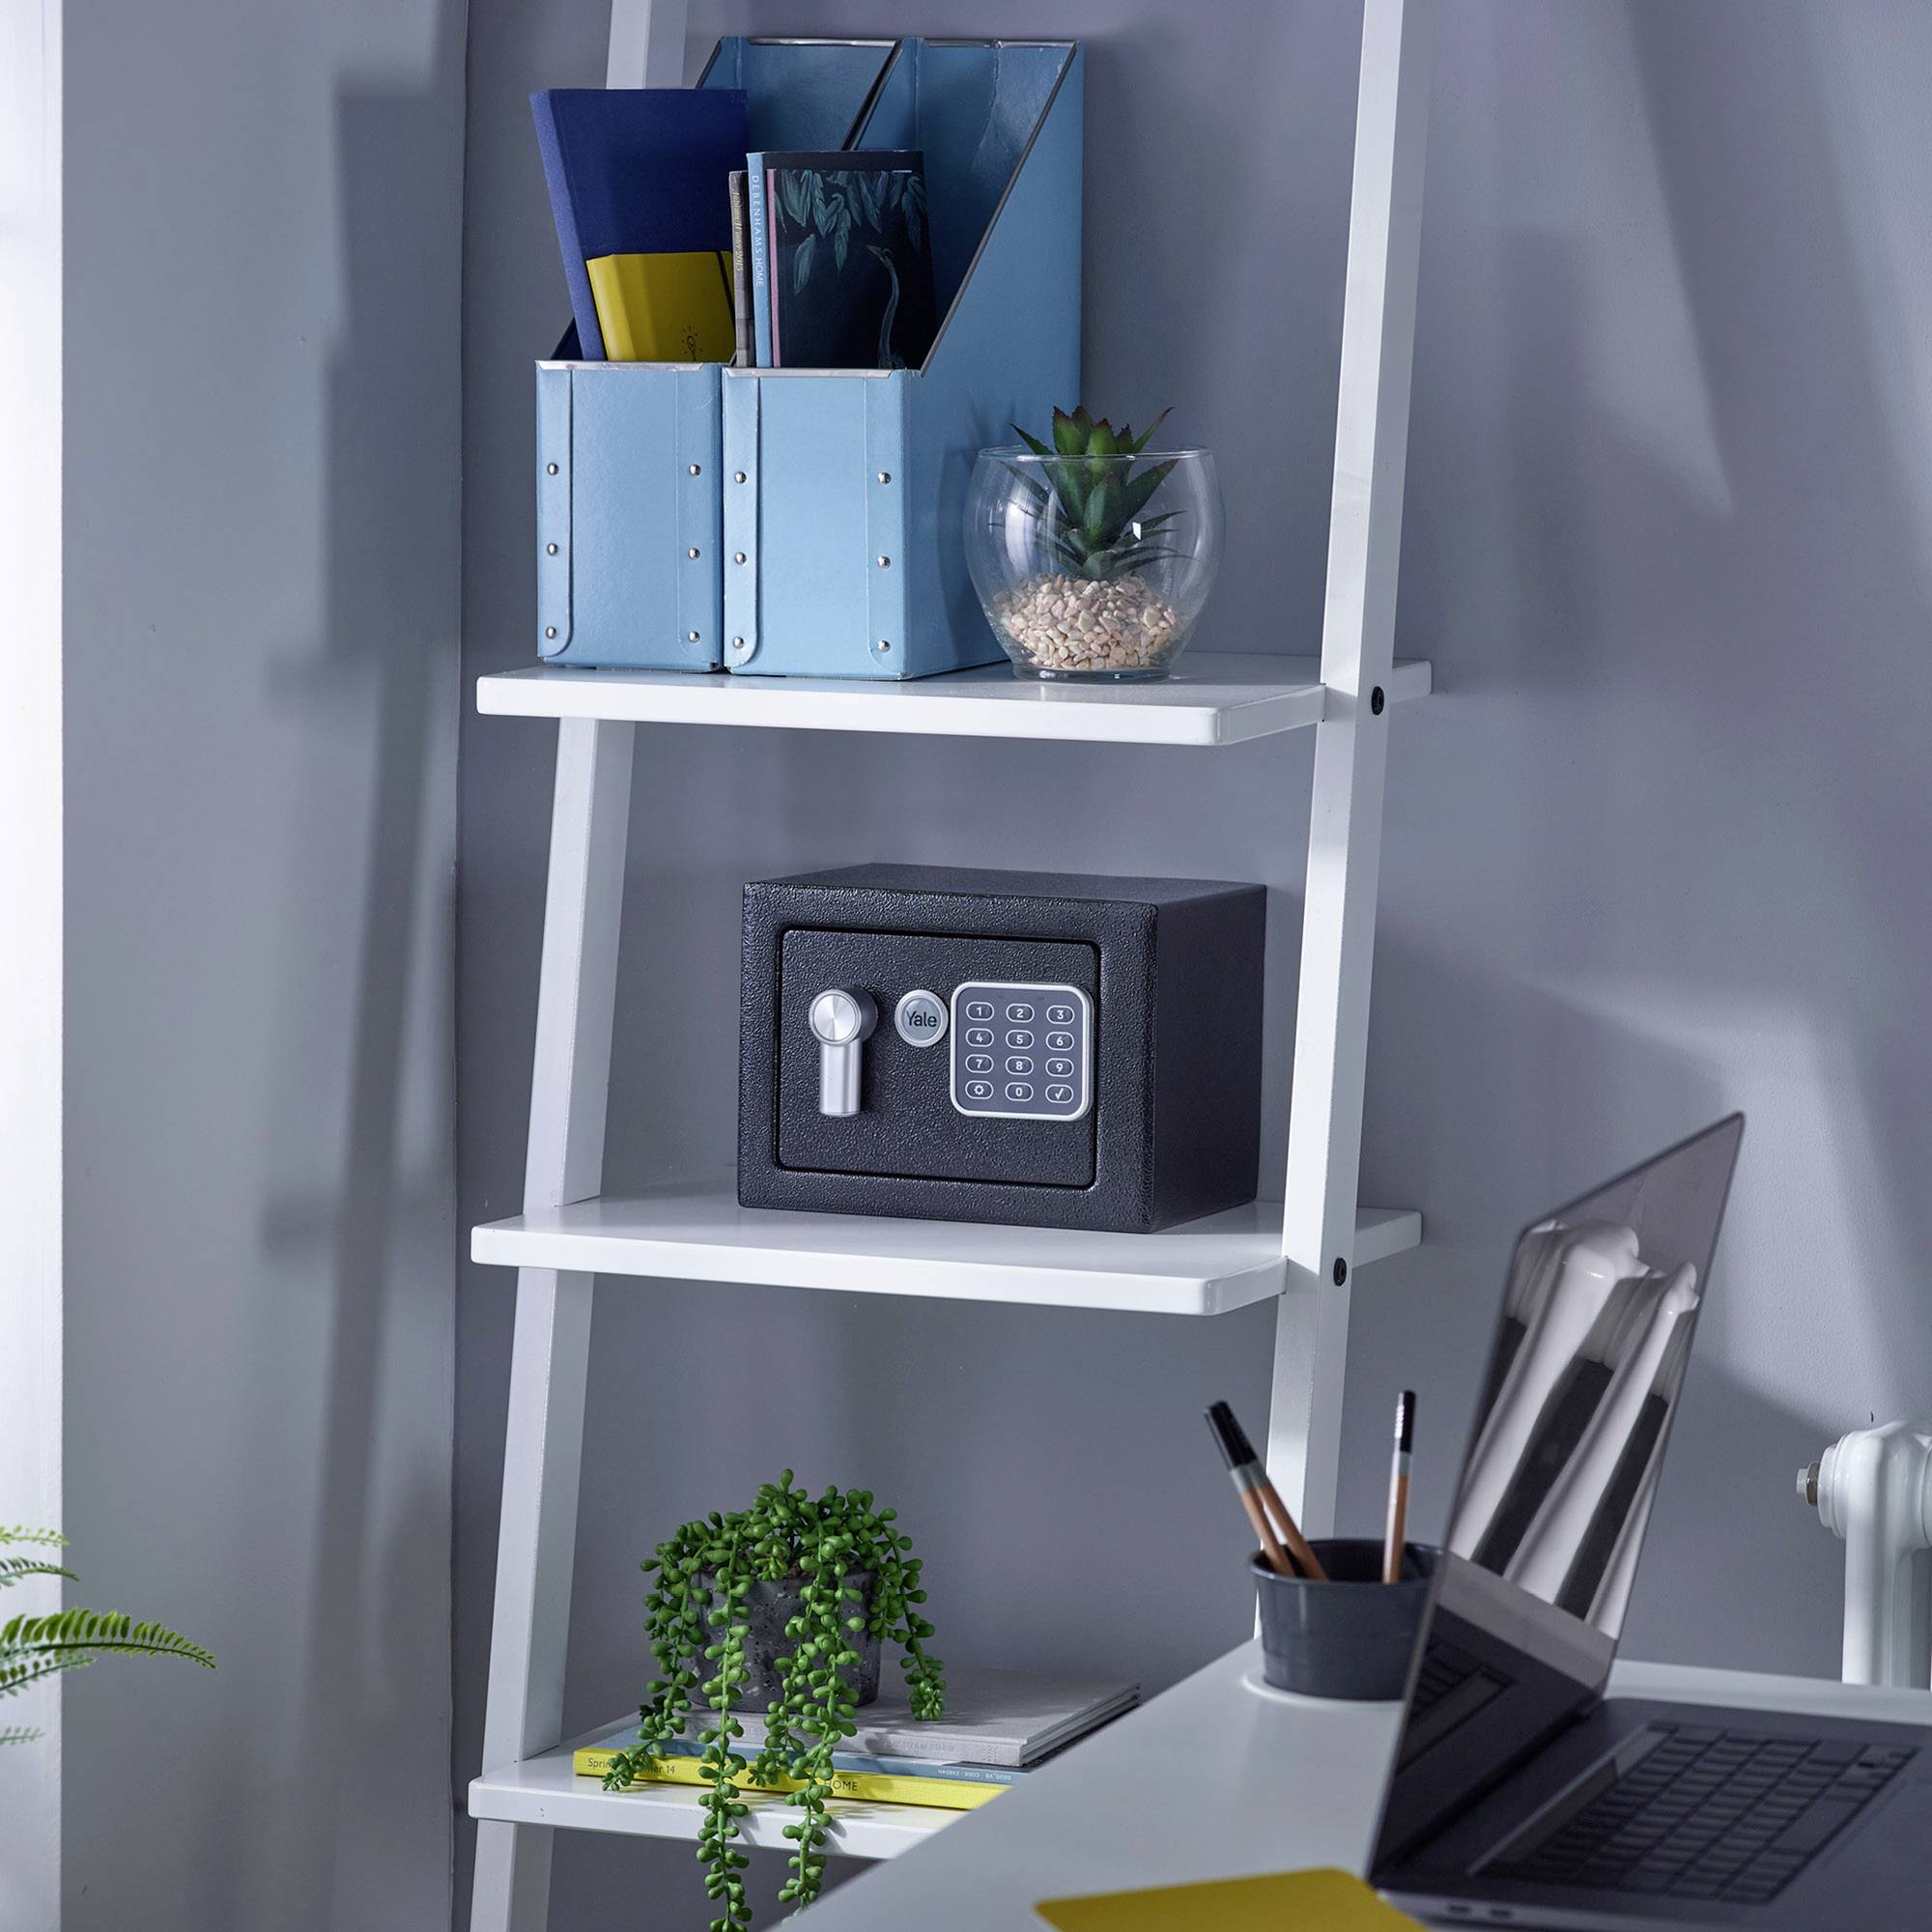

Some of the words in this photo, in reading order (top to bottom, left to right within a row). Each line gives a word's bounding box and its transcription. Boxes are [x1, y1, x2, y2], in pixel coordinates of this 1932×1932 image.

[752, 175, 763, 254] DEBENHAMS
[755, 258, 764, 287] HOME
[906, 1010, 938, 1028] Yale
[976, 1007, 982, 1016] 1
[1016, 1009, 1024, 1018] 2
[1057, 1010, 1064, 1020] 3
[976, 1033, 983, 1042] 4
[1016, 1035, 1023, 1044] 5
[1056, 1037, 1064, 1046] 6
[976, 1060, 982, 1068] 7
[1016, 1062, 1023, 1070] 8
[1056, 1063, 1064, 1072] 9
[1015, 1088, 1023, 1097] 0
